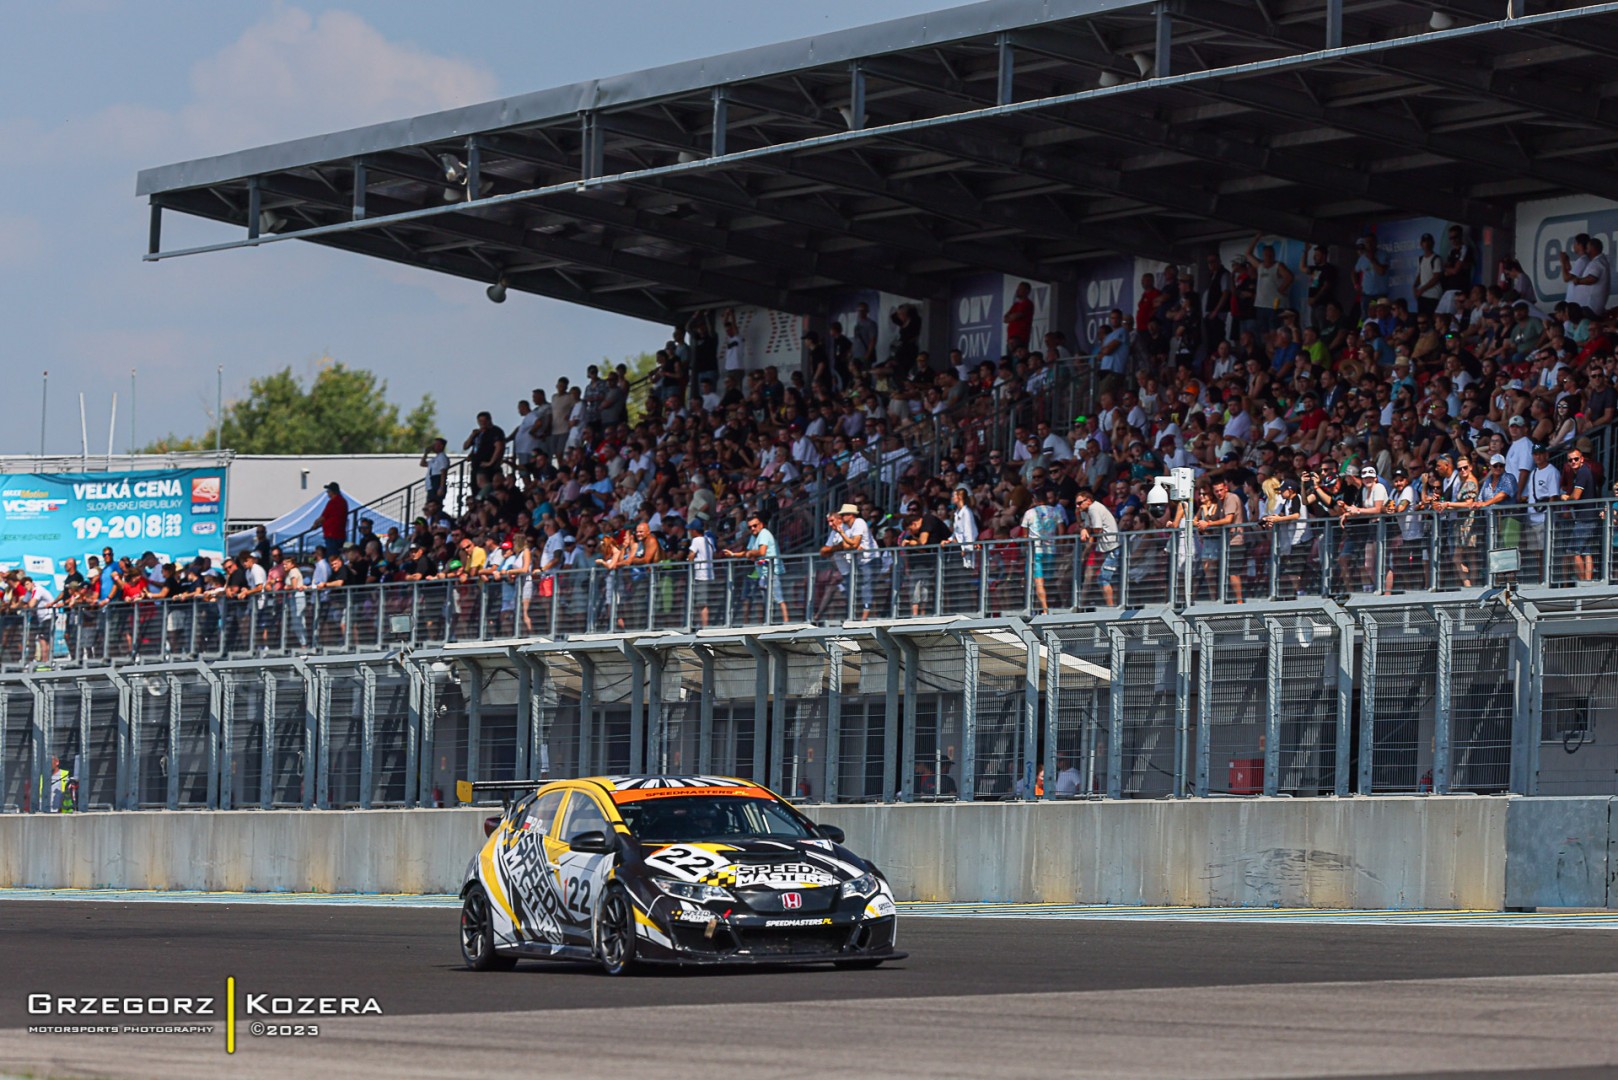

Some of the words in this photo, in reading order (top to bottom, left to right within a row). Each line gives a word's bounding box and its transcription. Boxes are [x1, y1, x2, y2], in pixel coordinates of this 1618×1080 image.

[960, 332, 991, 359] OMV
[73, 478, 131, 500] VEĽKÁ
[133, 479, 183, 498] CENA
[86, 501, 138, 512] SLOVENSKEJ
[139, 499, 183, 509] REPUBLIKY
[645, 789, 749, 798] SPEEDMASTERS.PL
[736, 863, 815, 874] SPEED
[735, 873, 833, 887] MASTERS
[765, 918, 833, 927] SPEEDMASTERS.PL
